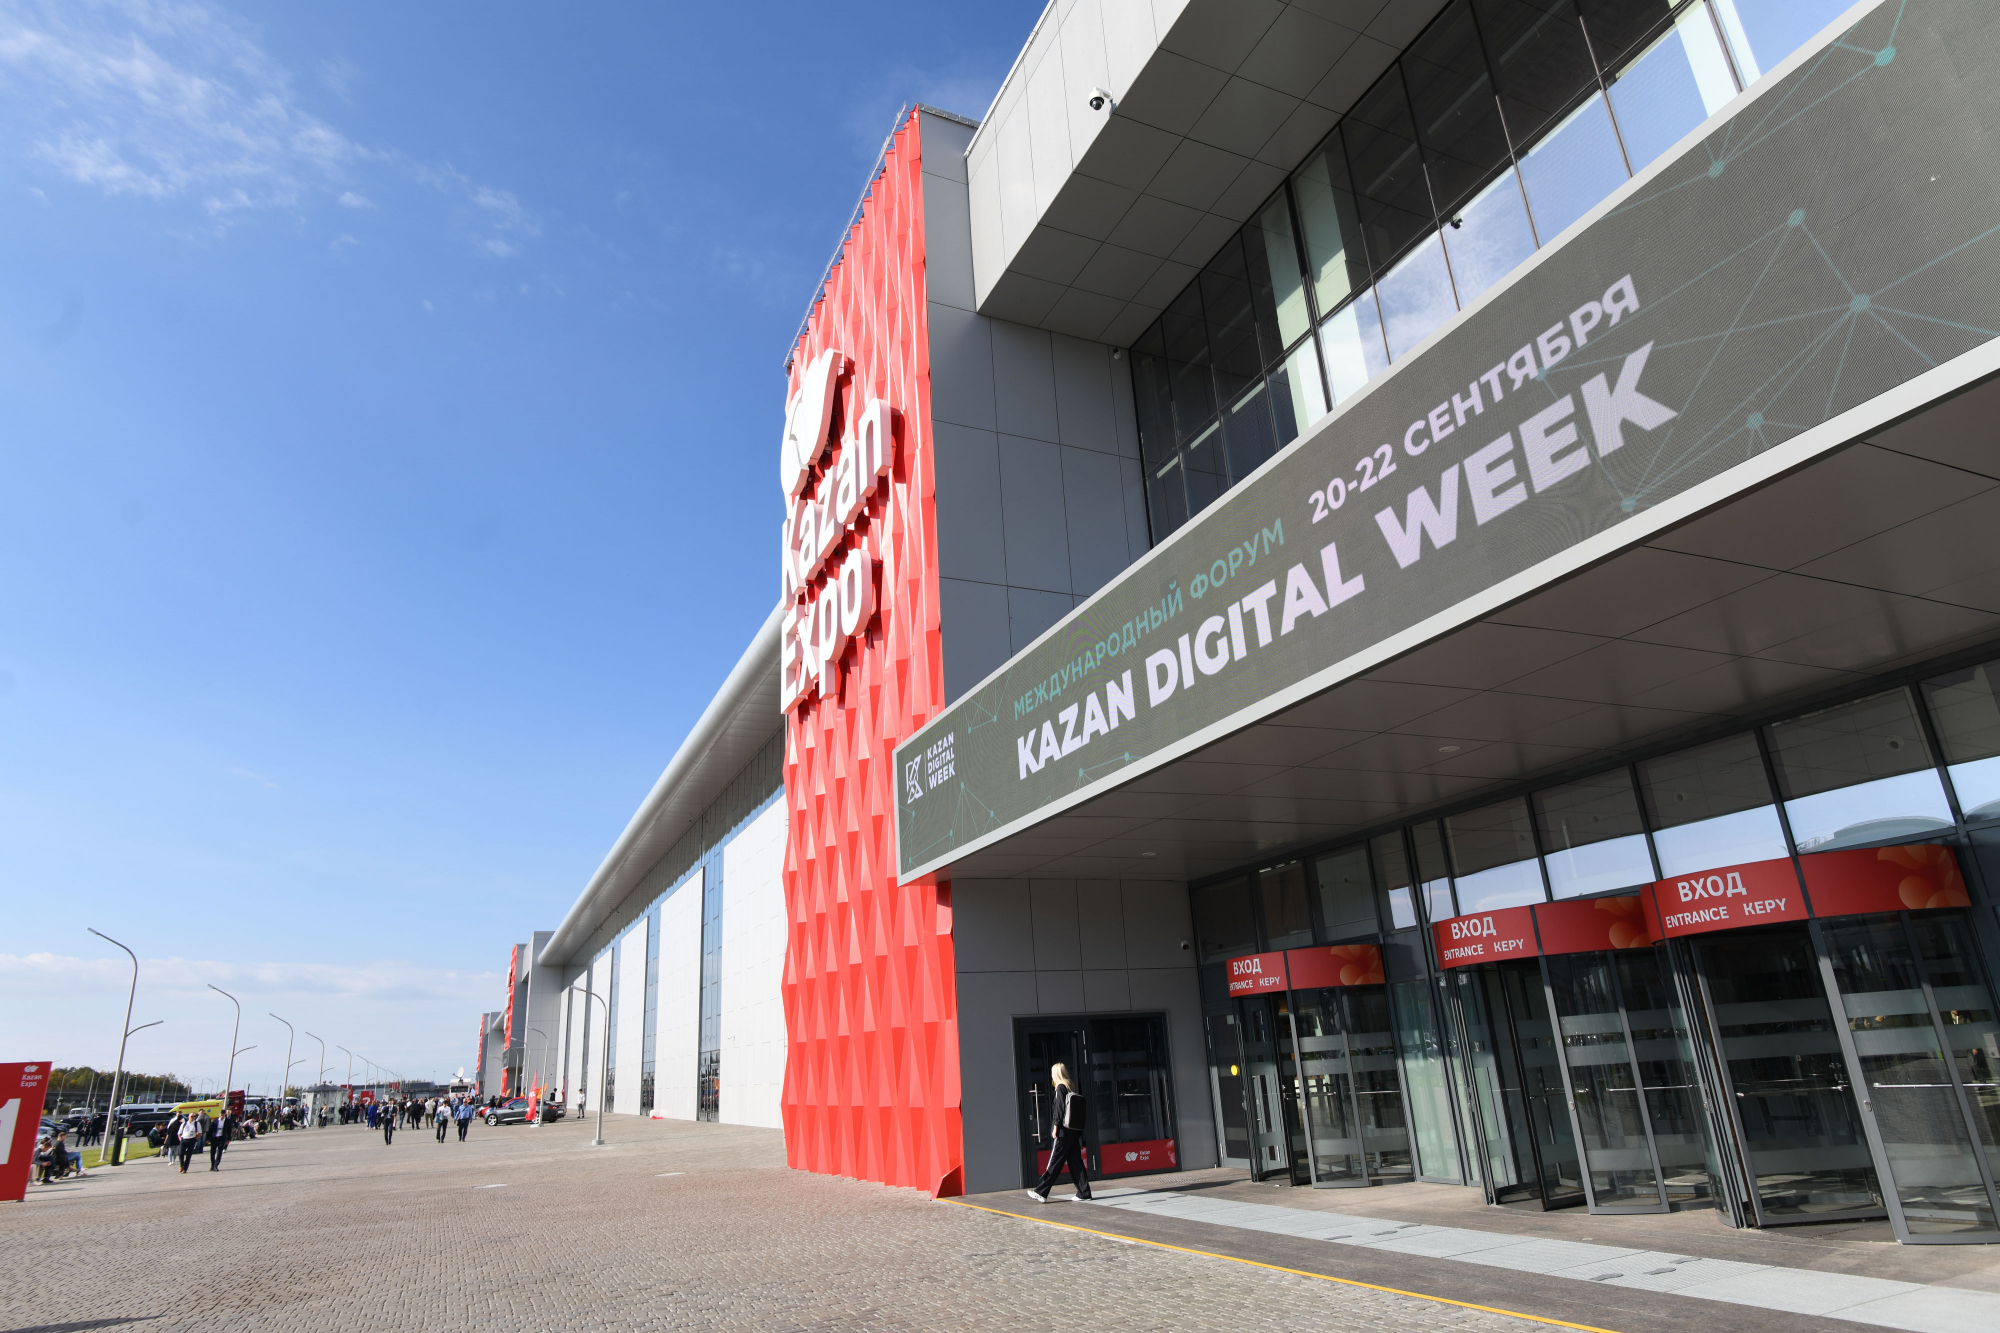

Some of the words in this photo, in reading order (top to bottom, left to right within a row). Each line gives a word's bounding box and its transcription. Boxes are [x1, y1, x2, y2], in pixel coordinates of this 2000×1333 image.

[1308, 443, 1398, 524] 20-22
[1403, 274, 1640, 457] СЕНТЯБРЯ
[782, 398, 892, 610] Kazan
[1017, 669, 1136, 781] KAZAN
[1145, 541, 1366, 709] DIGITAL
[1374, 339, 1679, 570] WEEK
[781, 549, 872, 714] Expo
[1014, 580, 1184, 720] МЕЖДУНАРОДНЫЙ
[1189, 517, 1285, 600] ФОРУМ
[927, 731, 954, 761] KAZAN
[928, 746, 955, 775] DIGITAL
[928, 761, 955, 790] WEEK
[1677, 871, 1748, 903] ВХОД
[1451, 916, 1497, 940] ВХОД
[1665, 906, 1730, 929] ENTRANCE
[1233, 958, 1262, 975] ВХОД
[1444, 944, 1484, 961] ENTRANCE
[0, 1098, 21, 1165] 1
